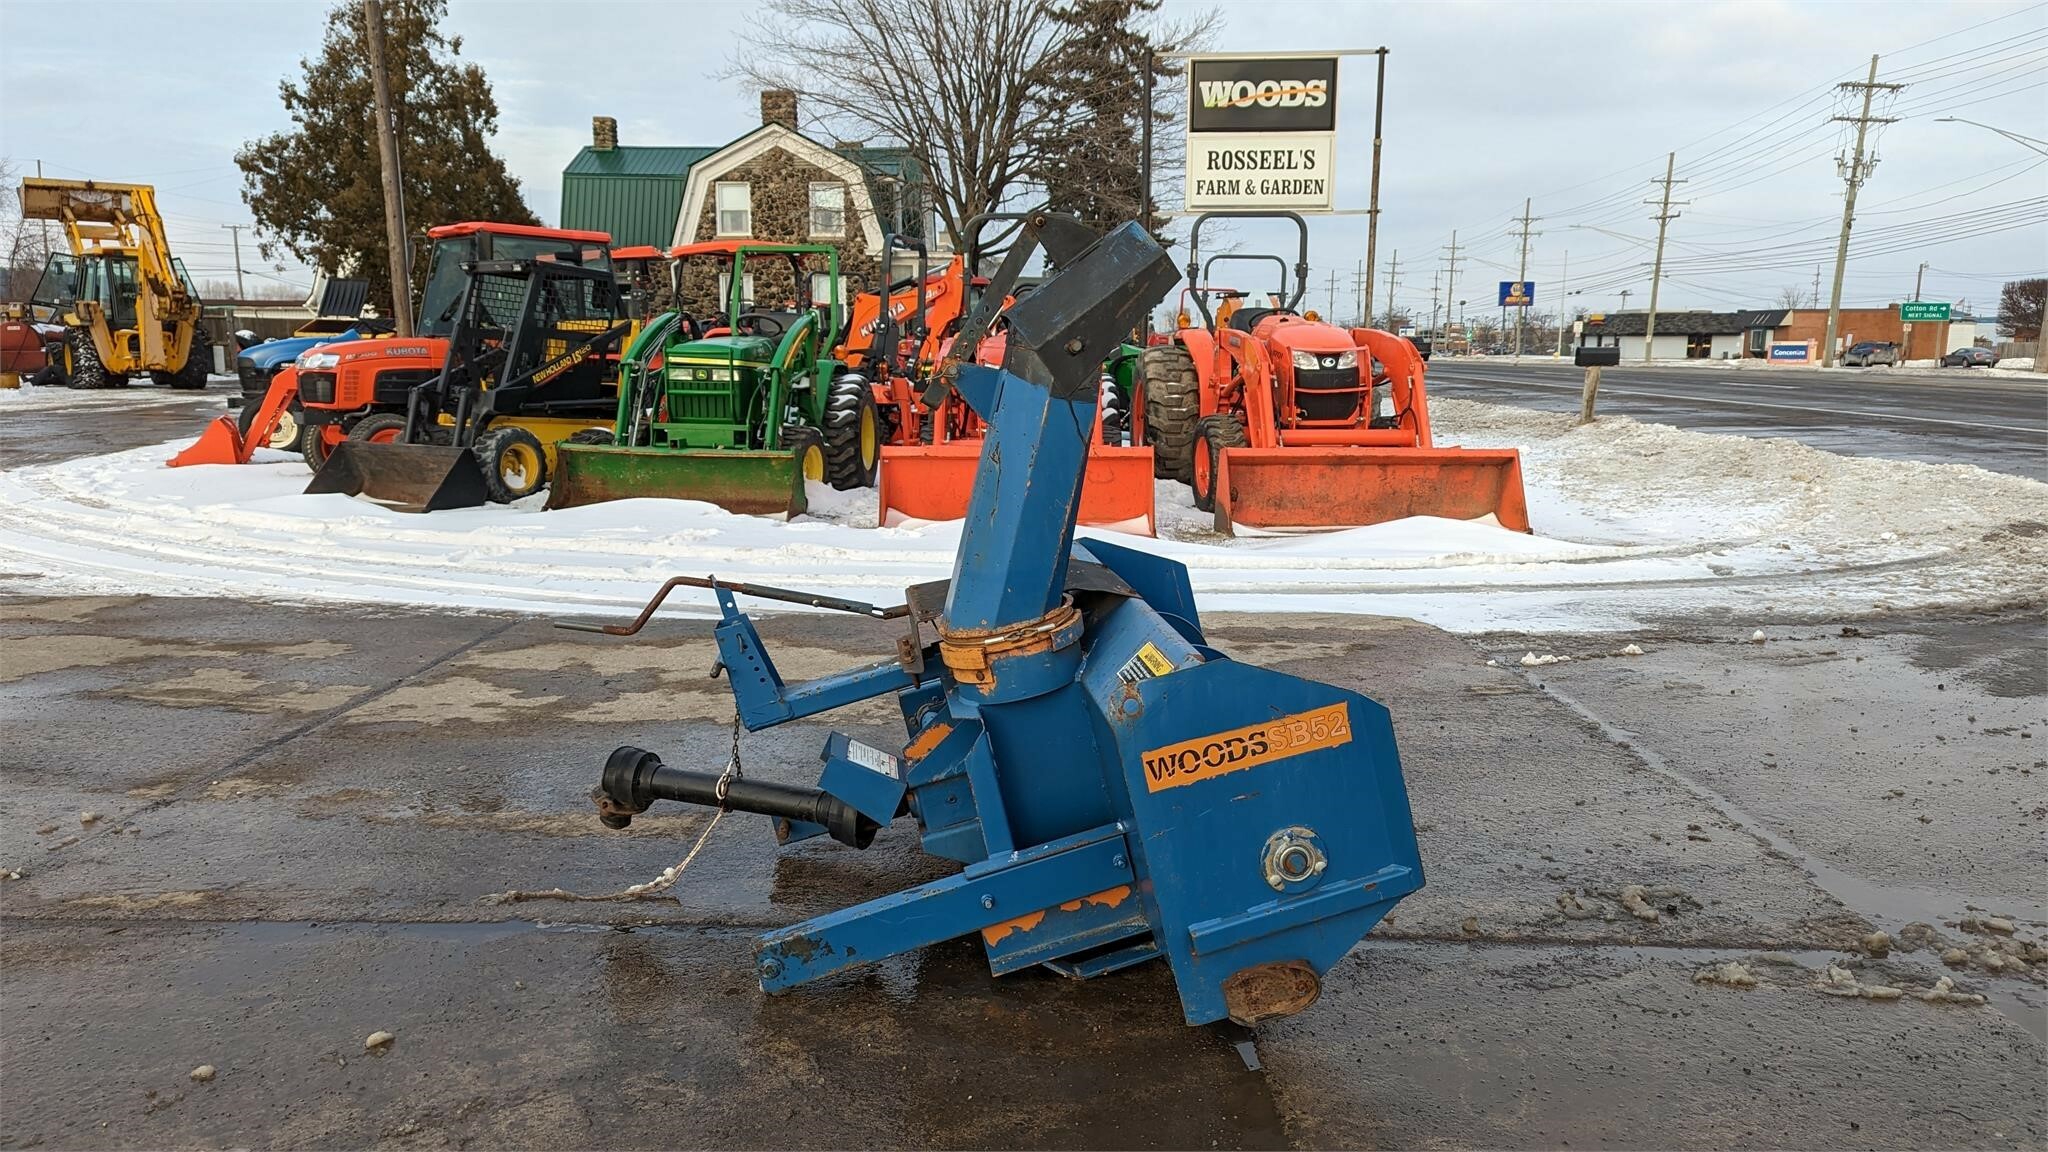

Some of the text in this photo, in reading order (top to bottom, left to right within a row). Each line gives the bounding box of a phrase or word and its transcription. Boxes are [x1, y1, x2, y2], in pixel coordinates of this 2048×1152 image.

[1199, 79, 1327, 108] WOODS
[1207, 149, 1316, 170] ROSSEEL'S
[1196, 178, 1325, 195] FARM & GARDEN
[385, 347, 428, 356] KUBOTA
[532, 369, 547, 384] NEW
[545, 356, 572, 376] HOLLAND
[1146, 711, 1347, 782] WOODS SB52
